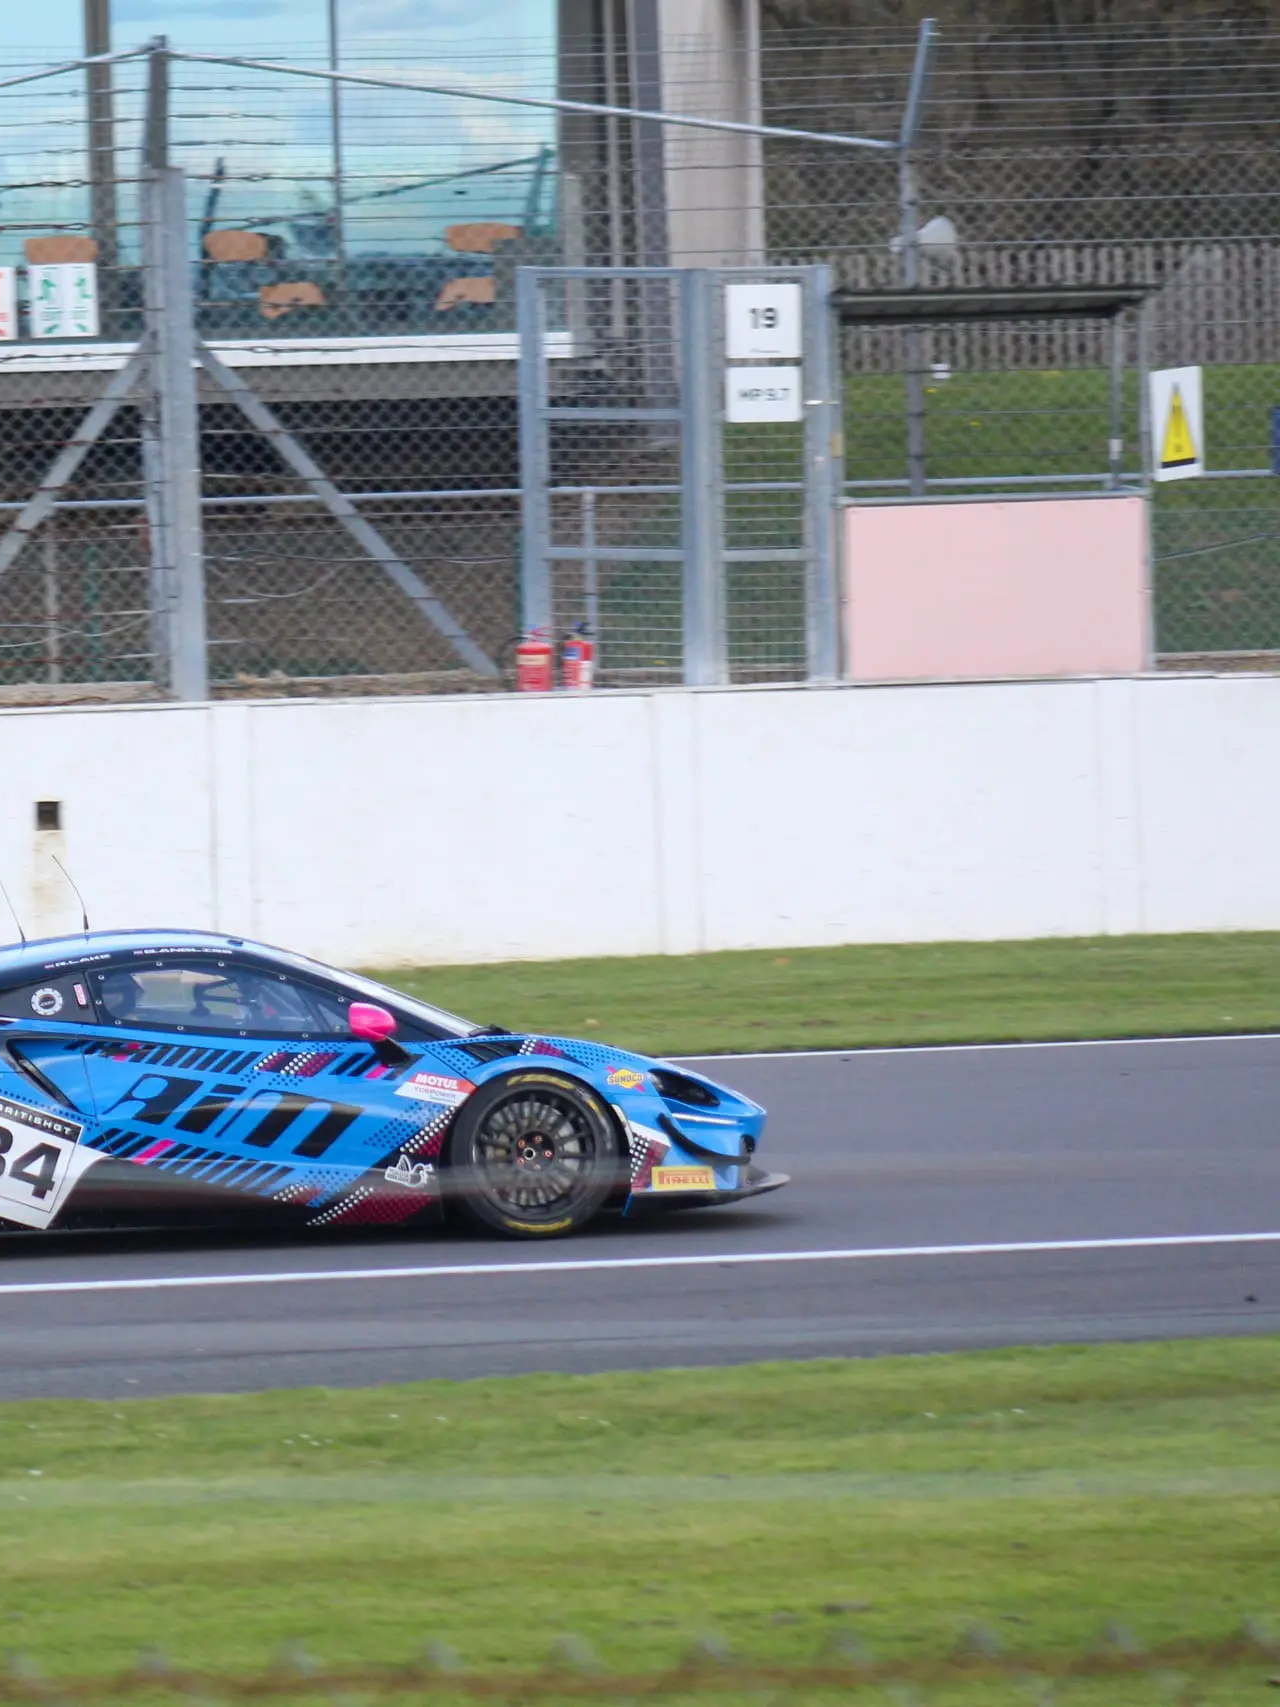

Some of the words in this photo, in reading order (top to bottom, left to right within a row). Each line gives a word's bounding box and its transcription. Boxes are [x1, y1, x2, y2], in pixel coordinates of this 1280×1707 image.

[749, 307, 778, 329] 19
[415, 1073, 458, 1090] MOTUL
[607, 1073, 643, 1085] SUNOCO
[657, 1170, 710, 1185] PIRELLI
